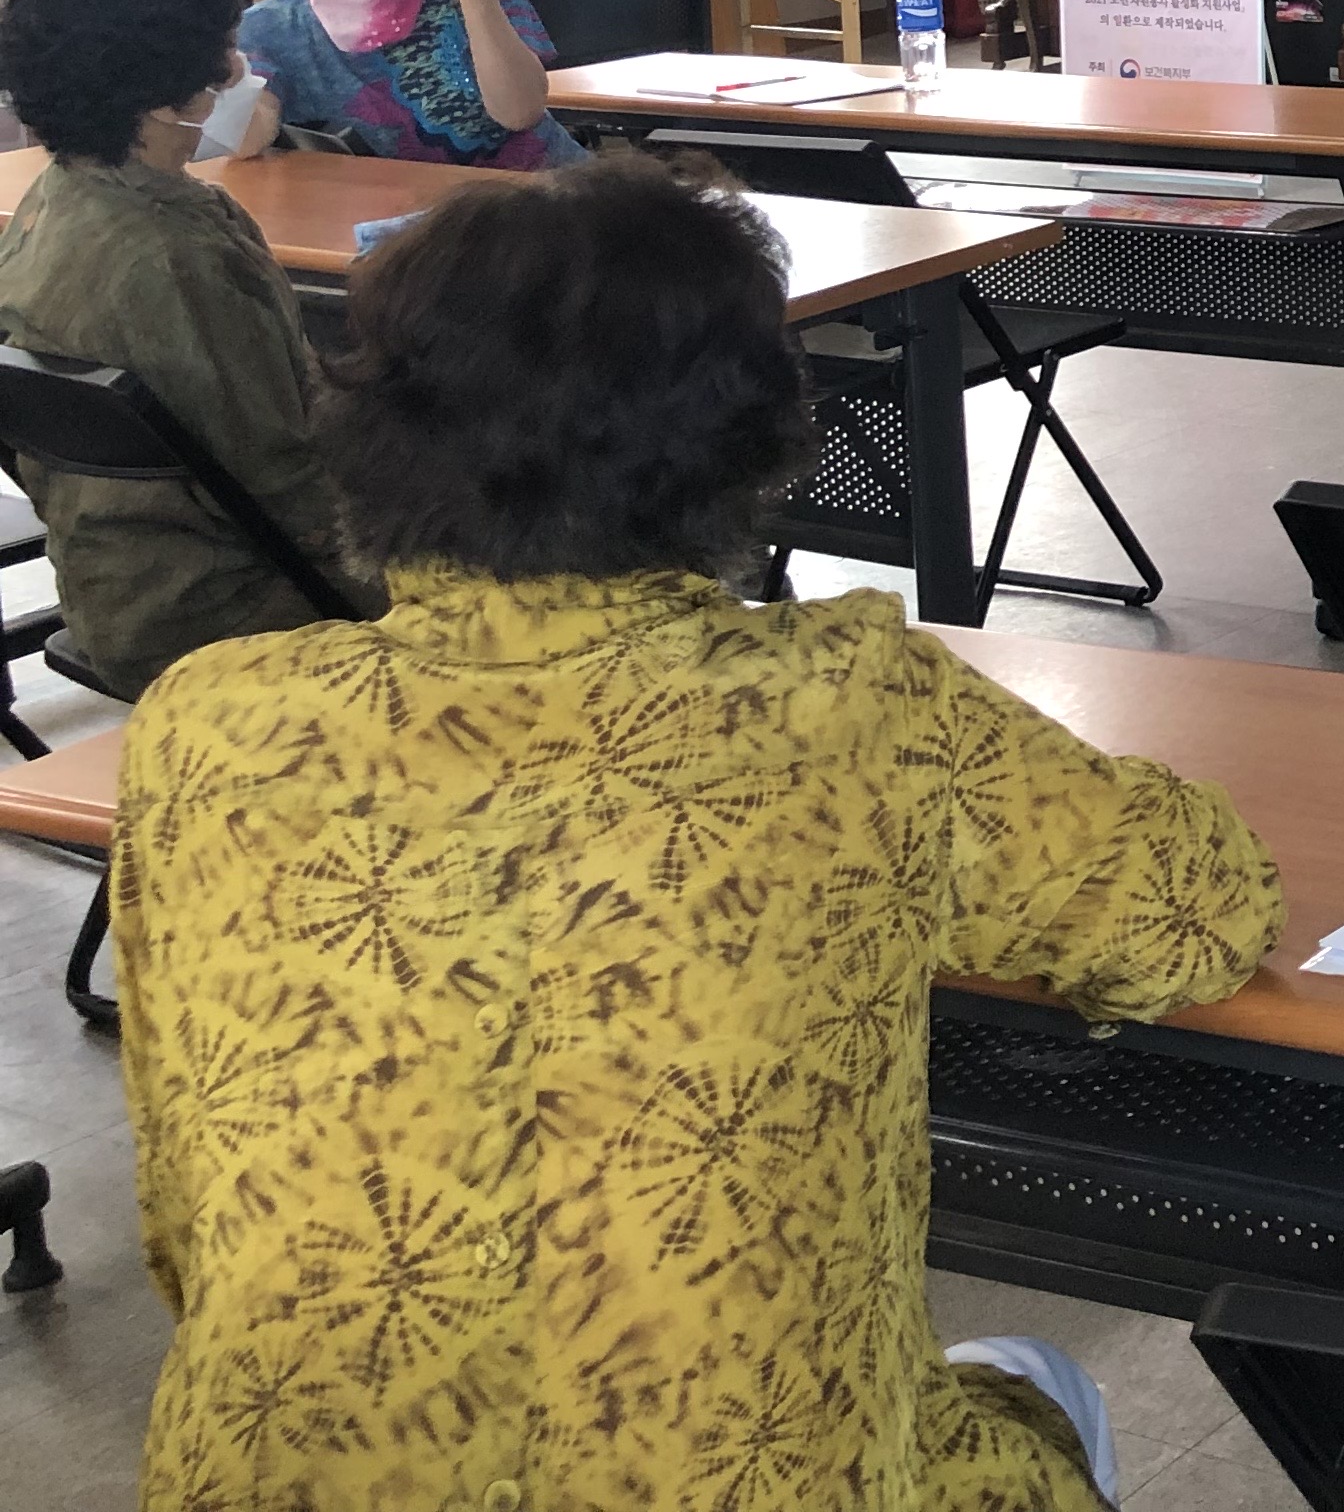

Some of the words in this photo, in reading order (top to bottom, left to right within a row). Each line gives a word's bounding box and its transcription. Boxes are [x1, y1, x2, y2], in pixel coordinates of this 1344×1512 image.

[1100, 13, 1110, 26] 의
[1113, 14, 1152, 28] 일환으로
[1144, 66, 1191, 80] 보건복지부
